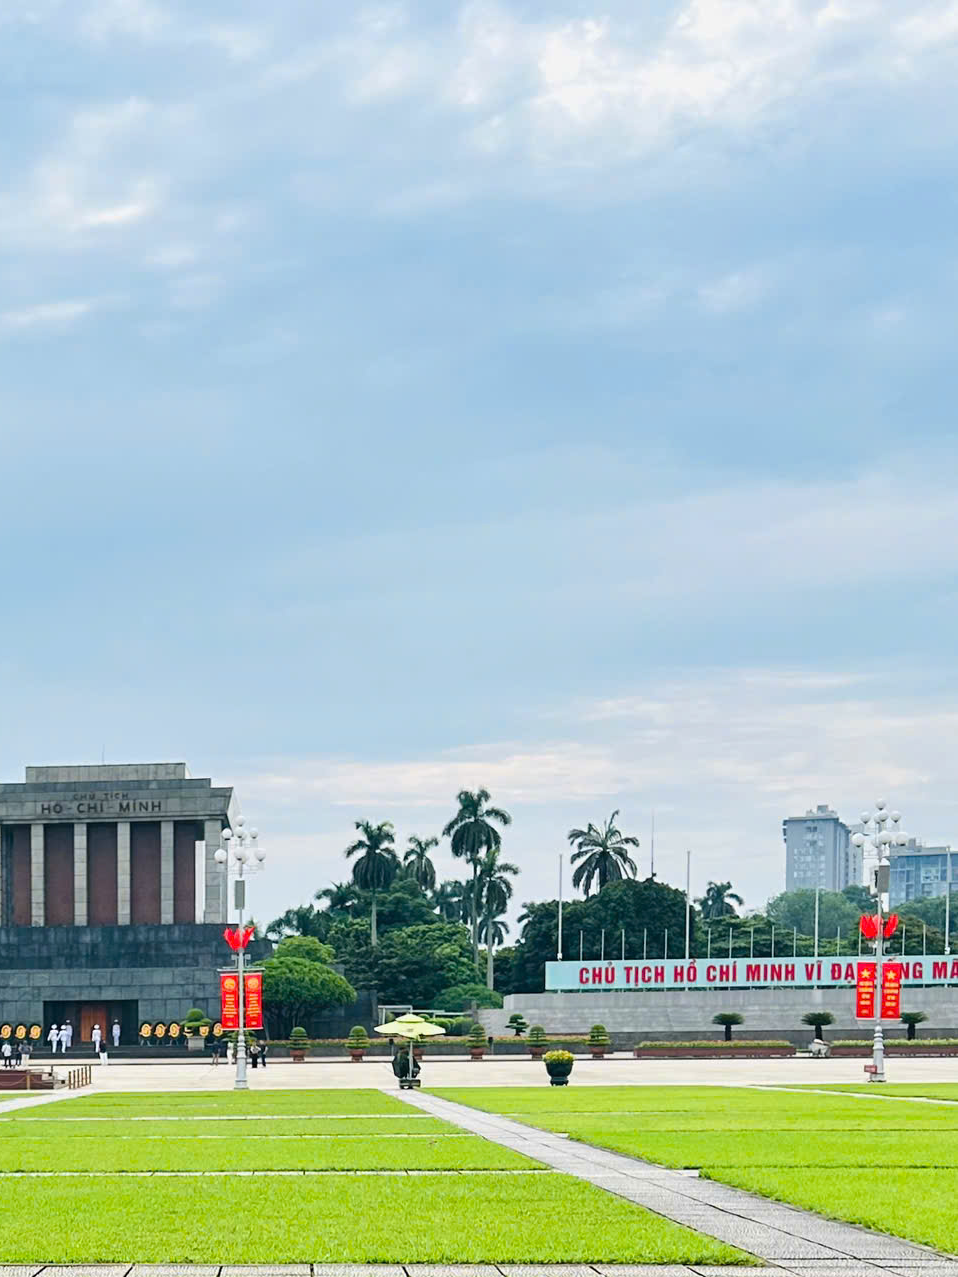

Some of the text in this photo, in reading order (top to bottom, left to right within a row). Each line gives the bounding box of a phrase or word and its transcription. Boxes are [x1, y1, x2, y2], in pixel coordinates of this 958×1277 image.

[579, 961, 615, 985] CHỦ
[624, 965, 665, 987] TỊCH
[706, 960, 737, 982] CHÍ
[745, 963, 796, 982] MINH
[804, 960, 822, 981] VĨ
[830, 963, 857, 984] ĐẠ
